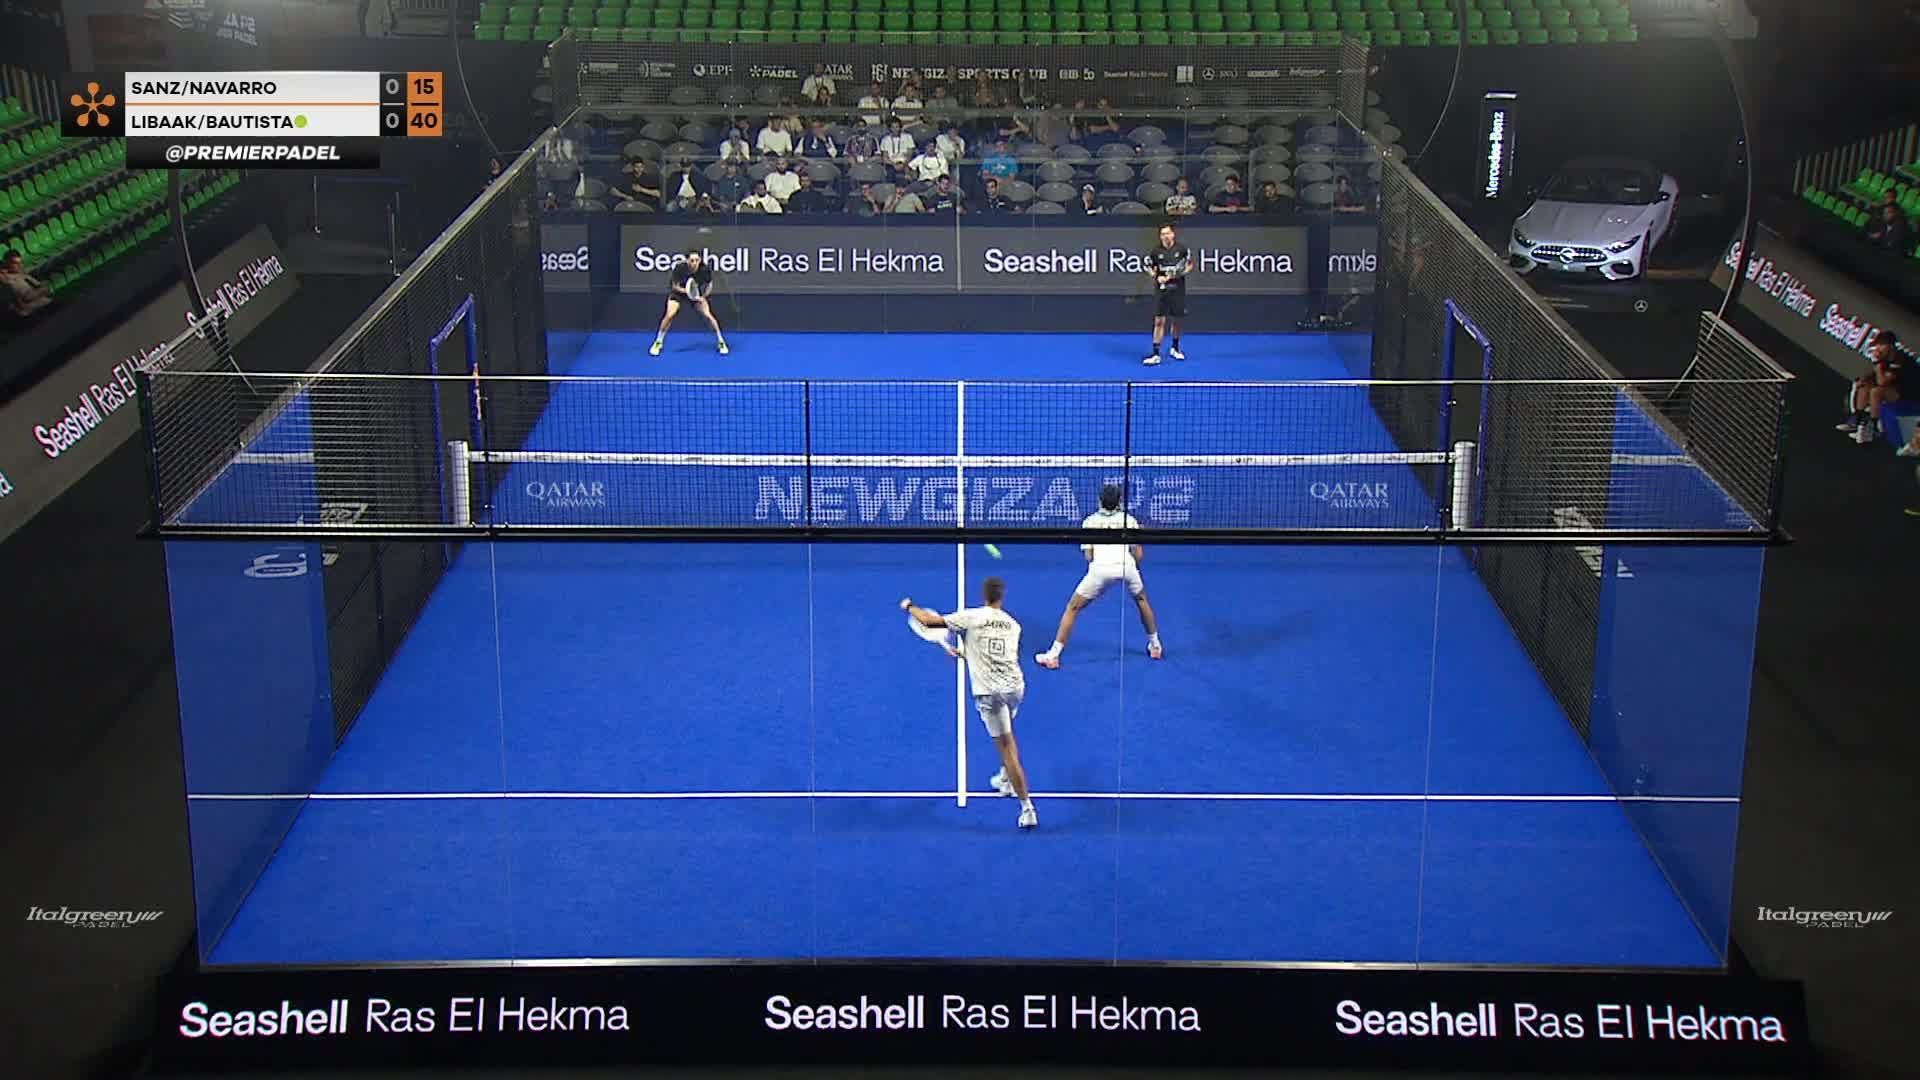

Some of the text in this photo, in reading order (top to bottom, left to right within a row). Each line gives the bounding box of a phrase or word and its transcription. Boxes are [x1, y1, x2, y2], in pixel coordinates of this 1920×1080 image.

[762, 69, 798, 79] PADEL
[824, 64, 853, 75] ATAR
[1012, 67, 1048, 80] CUB
[635, 246, 945, 273] Seahell Ras El Hekma
[984, 248, 1097, 273] Seashell
[1200, 248, 1293, 273] Hekma
[223, 282, 250, 310] Ras
[33, 393, 104, 459] Seashell
[90, 384, 127, 417] Ras
[112, 363, 138, 398] El
[526, 481, 606, 500] QATAR
[753, 475, 1084, 522] NEWGIZA
[1310, 481, 1390, 501] QATAR
[548, 498, 606, 509] AIRWAYS
[1330, 498, 1390, 509] AIRWAYS
[179, 997, 630, 1037] Seashell Ras El Hekma
[764, 995, 1201, 1032] Seashell Ras El Hekma
[1335, 1000, 1787, 1042] Seashell Ras El Hekma
